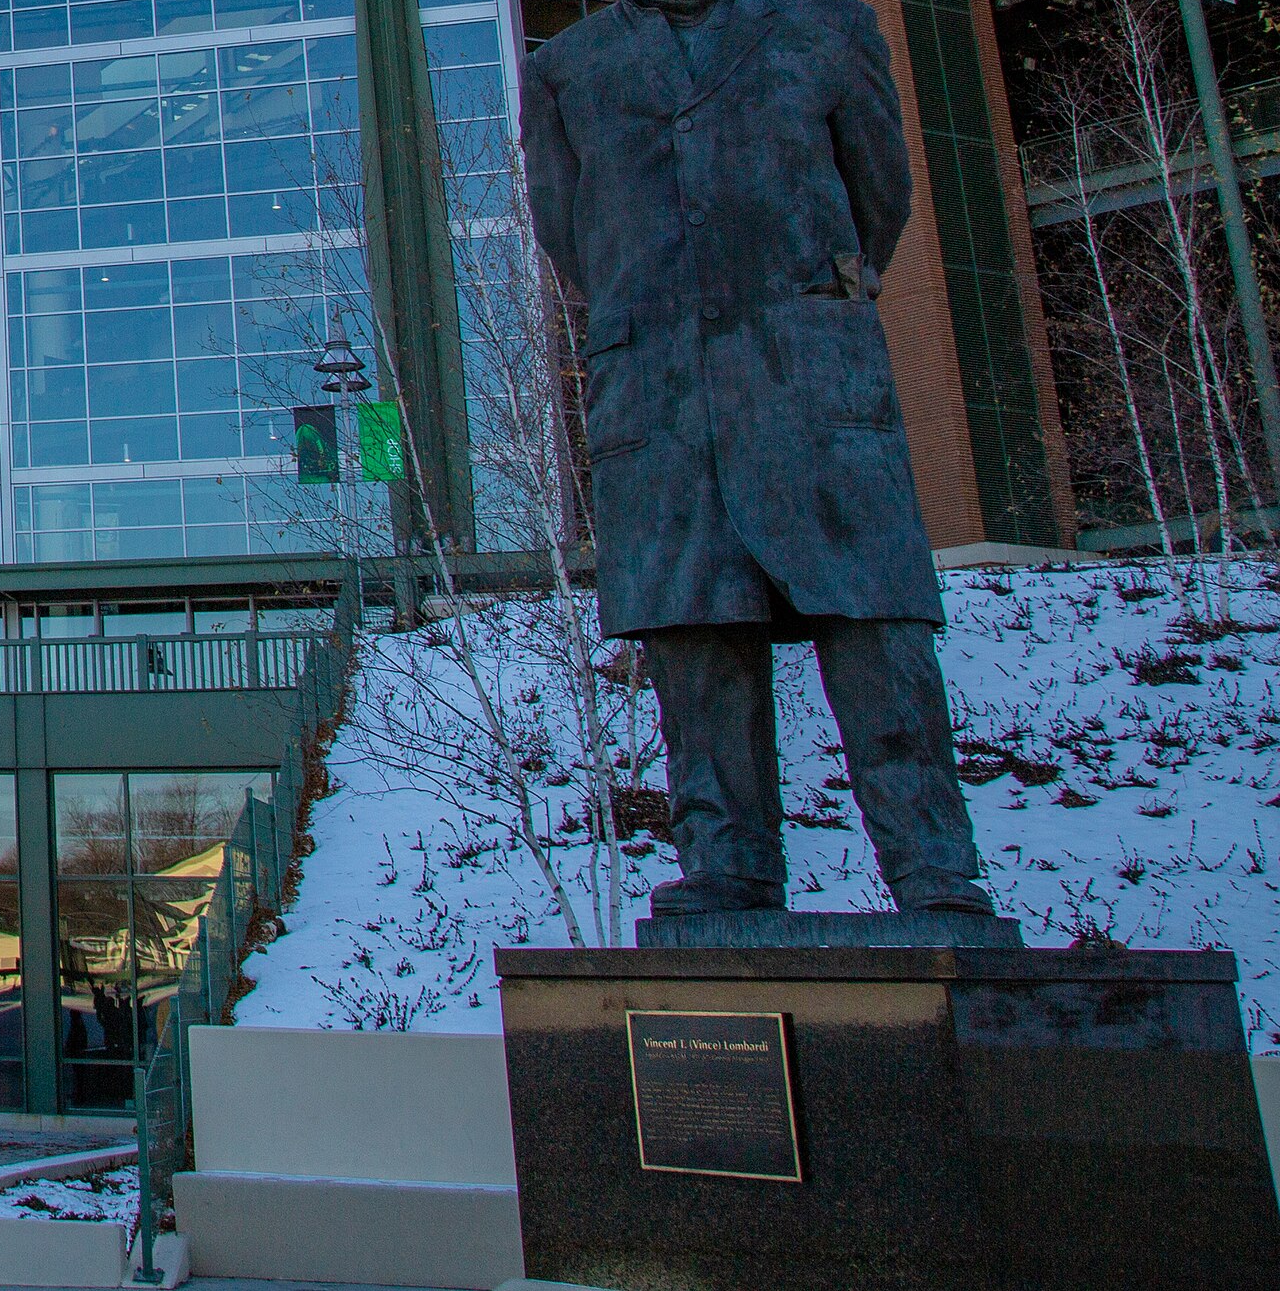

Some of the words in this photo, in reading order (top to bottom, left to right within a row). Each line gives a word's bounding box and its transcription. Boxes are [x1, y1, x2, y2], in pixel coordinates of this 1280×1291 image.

[386, 438, 402, 475] SHOP
[643, 1037, 677, 1050] Vincent
[689, 1038, 722, 1051] (Vince)
[723, 1040, 769, 1052] Lombardi
